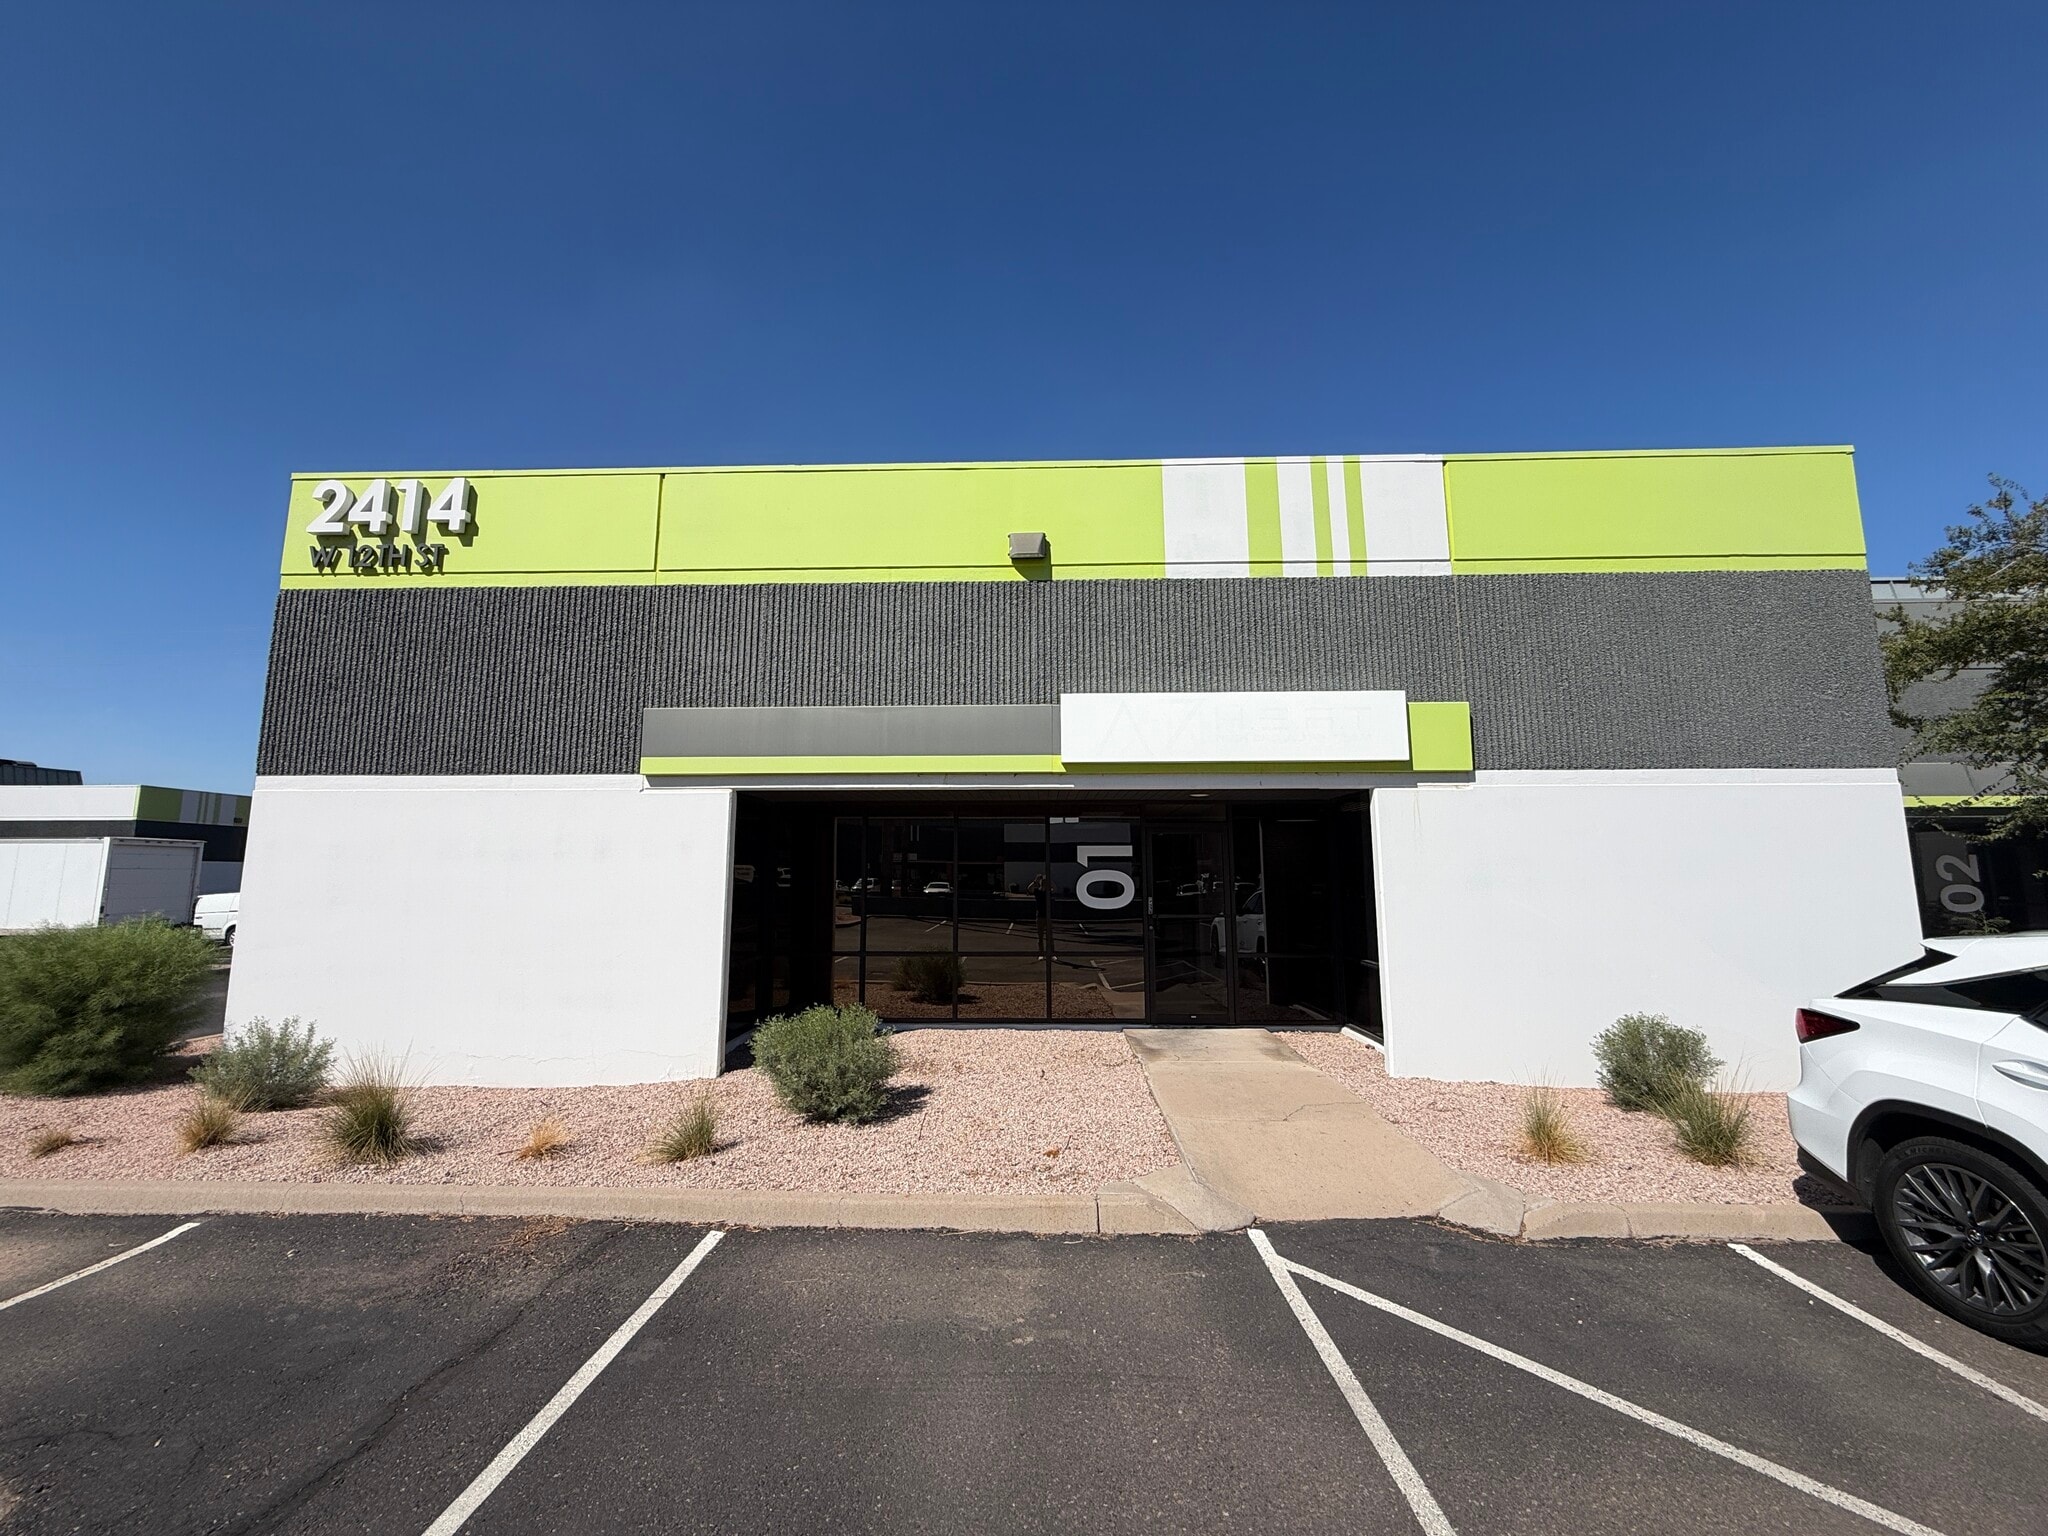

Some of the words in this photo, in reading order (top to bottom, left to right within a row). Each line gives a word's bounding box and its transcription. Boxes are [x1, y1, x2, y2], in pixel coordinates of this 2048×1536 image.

[306, 477, 471, 535] 2414
[310, 544, 338, 568] W
[347, 543, 409, 567] 12TH
[414, 542, 447, 567] ST
[1076, 845, 1135, 910] 01
[1936, 854, 1985, 913] 02
